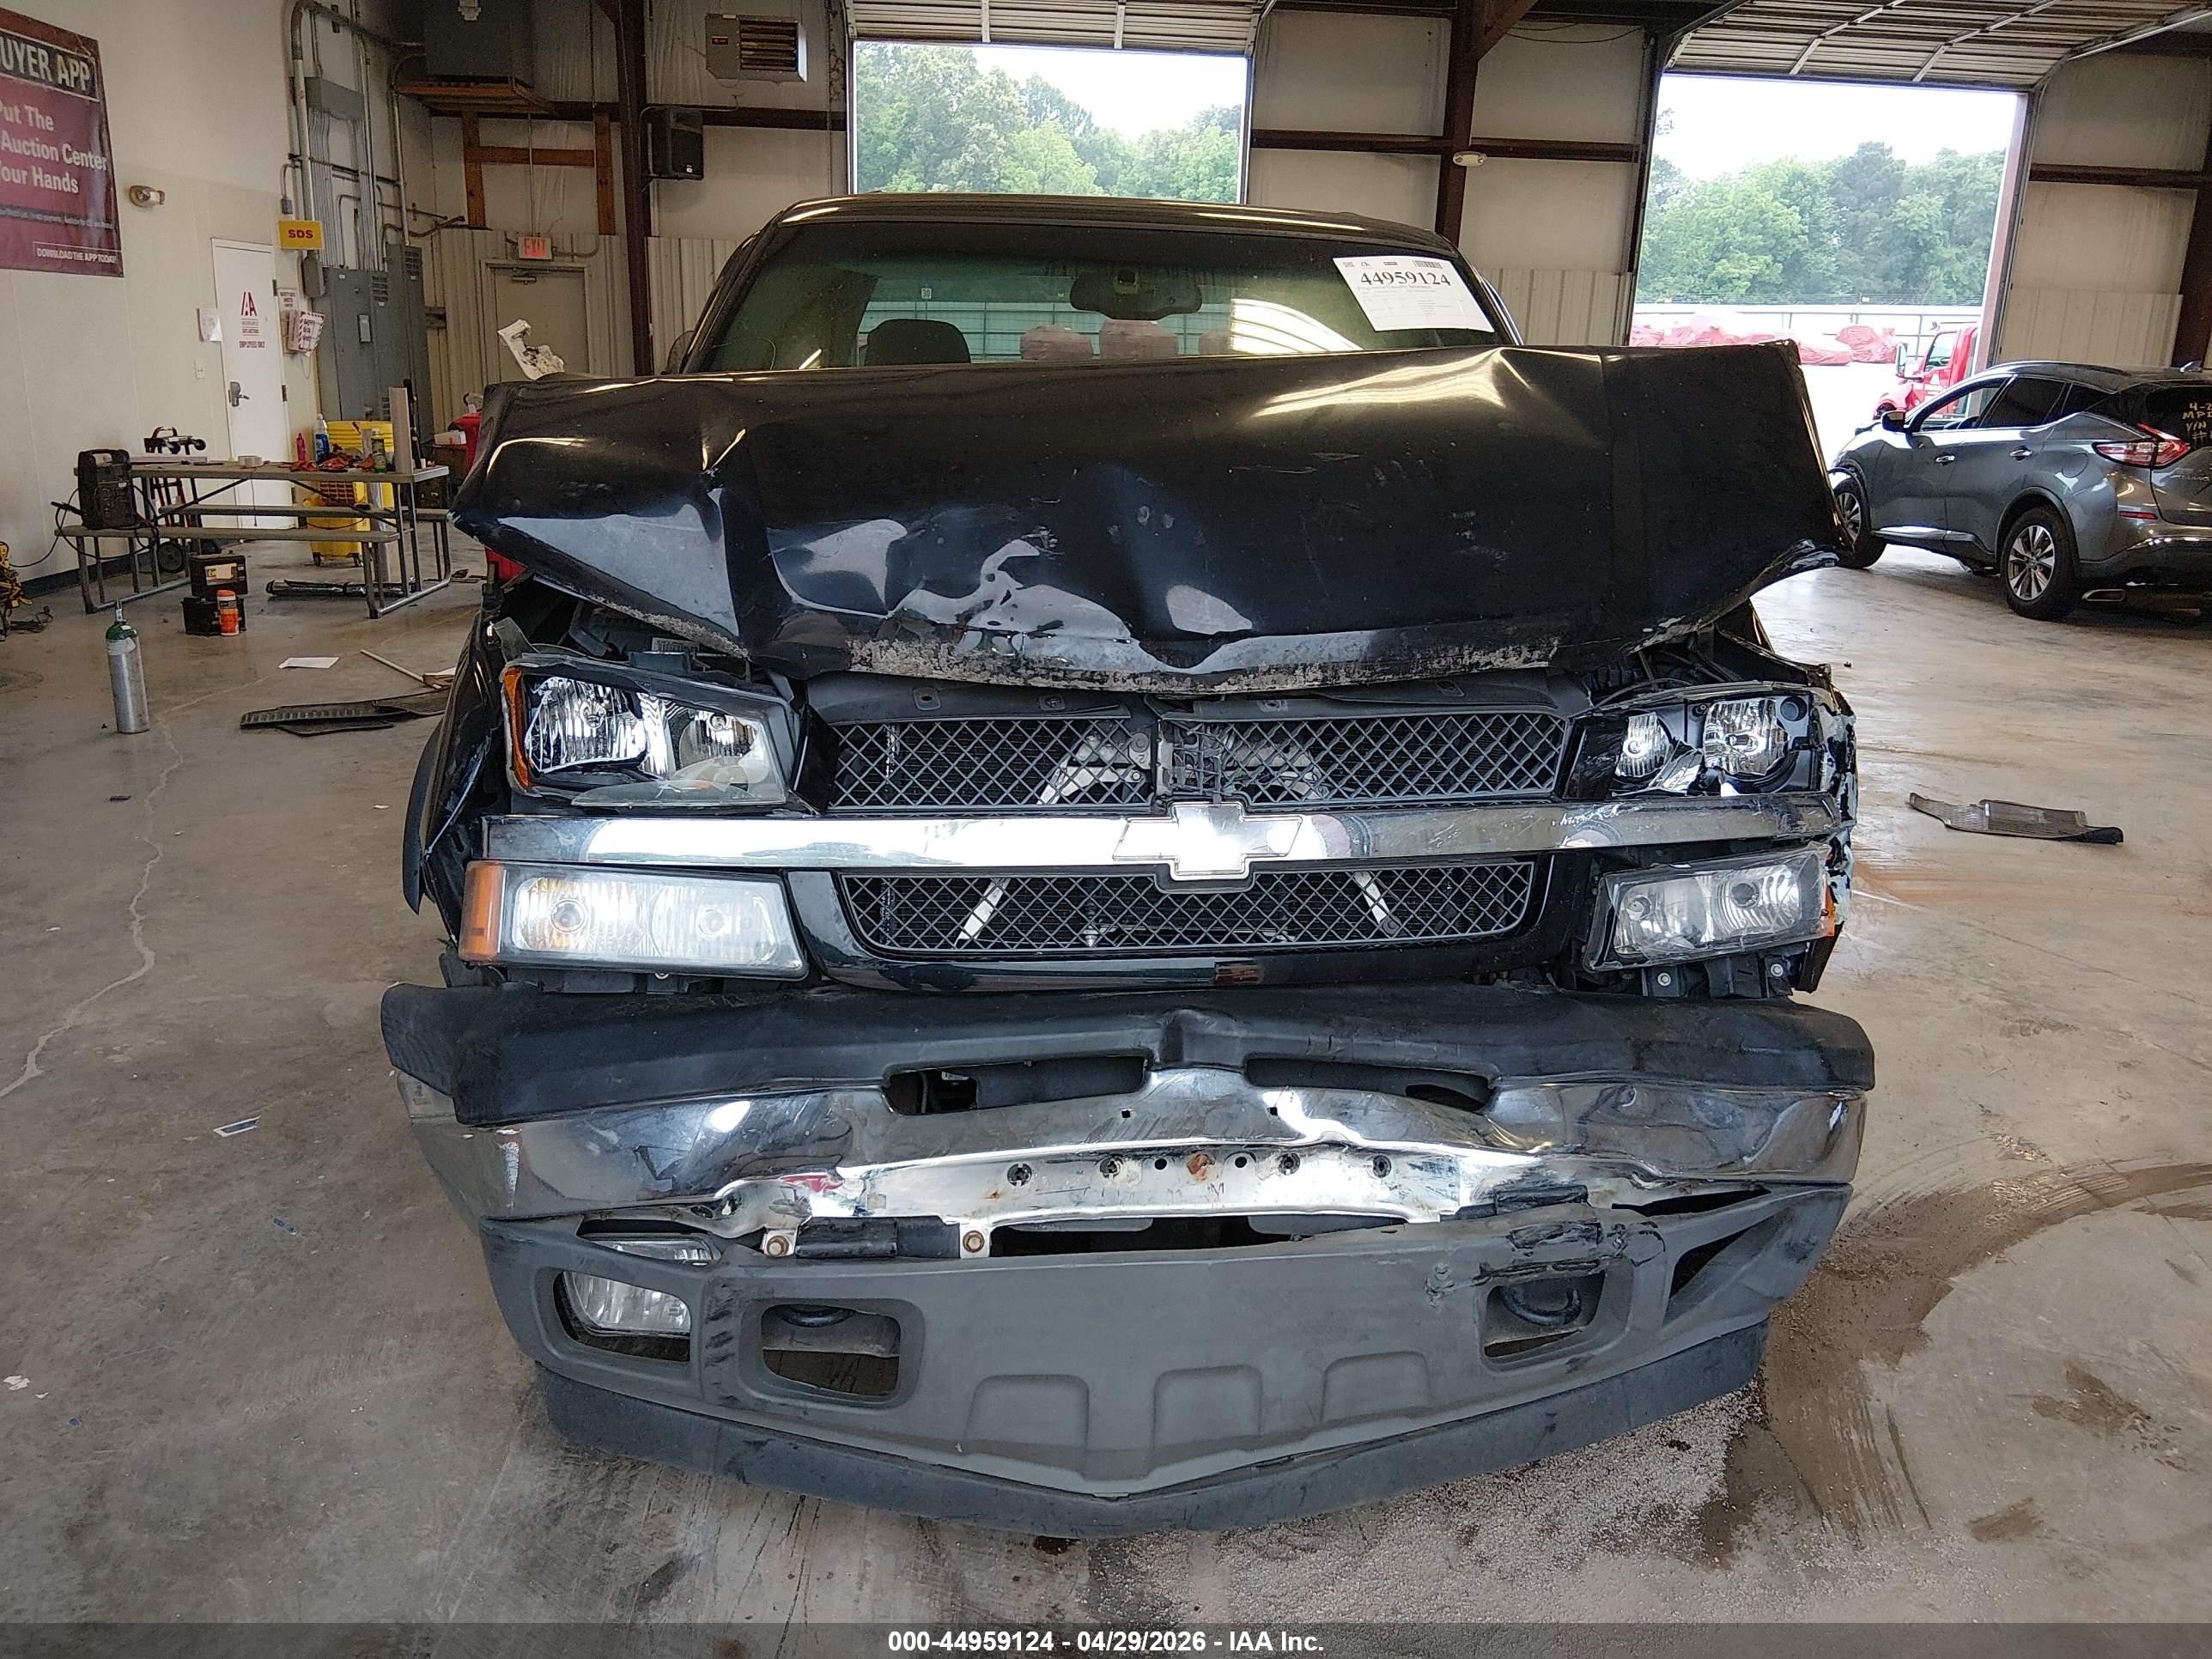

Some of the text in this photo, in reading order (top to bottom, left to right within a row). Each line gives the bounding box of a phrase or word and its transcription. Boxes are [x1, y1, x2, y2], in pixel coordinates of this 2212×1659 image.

[57, 54, 89, 90] APP
[24, 104, 53, 131] The
[1, 130, 106, 171] Auction Center
[0, 161, 78, 193] our Hands
[288, 229, 313, 239] SDS
[37, 248, 73, 259] DOWNLOAD
[84, 253, 97, 262] APP
[524, 238, 546, 255] EXIT
[1360, 270, 1451, 286] 44959124
